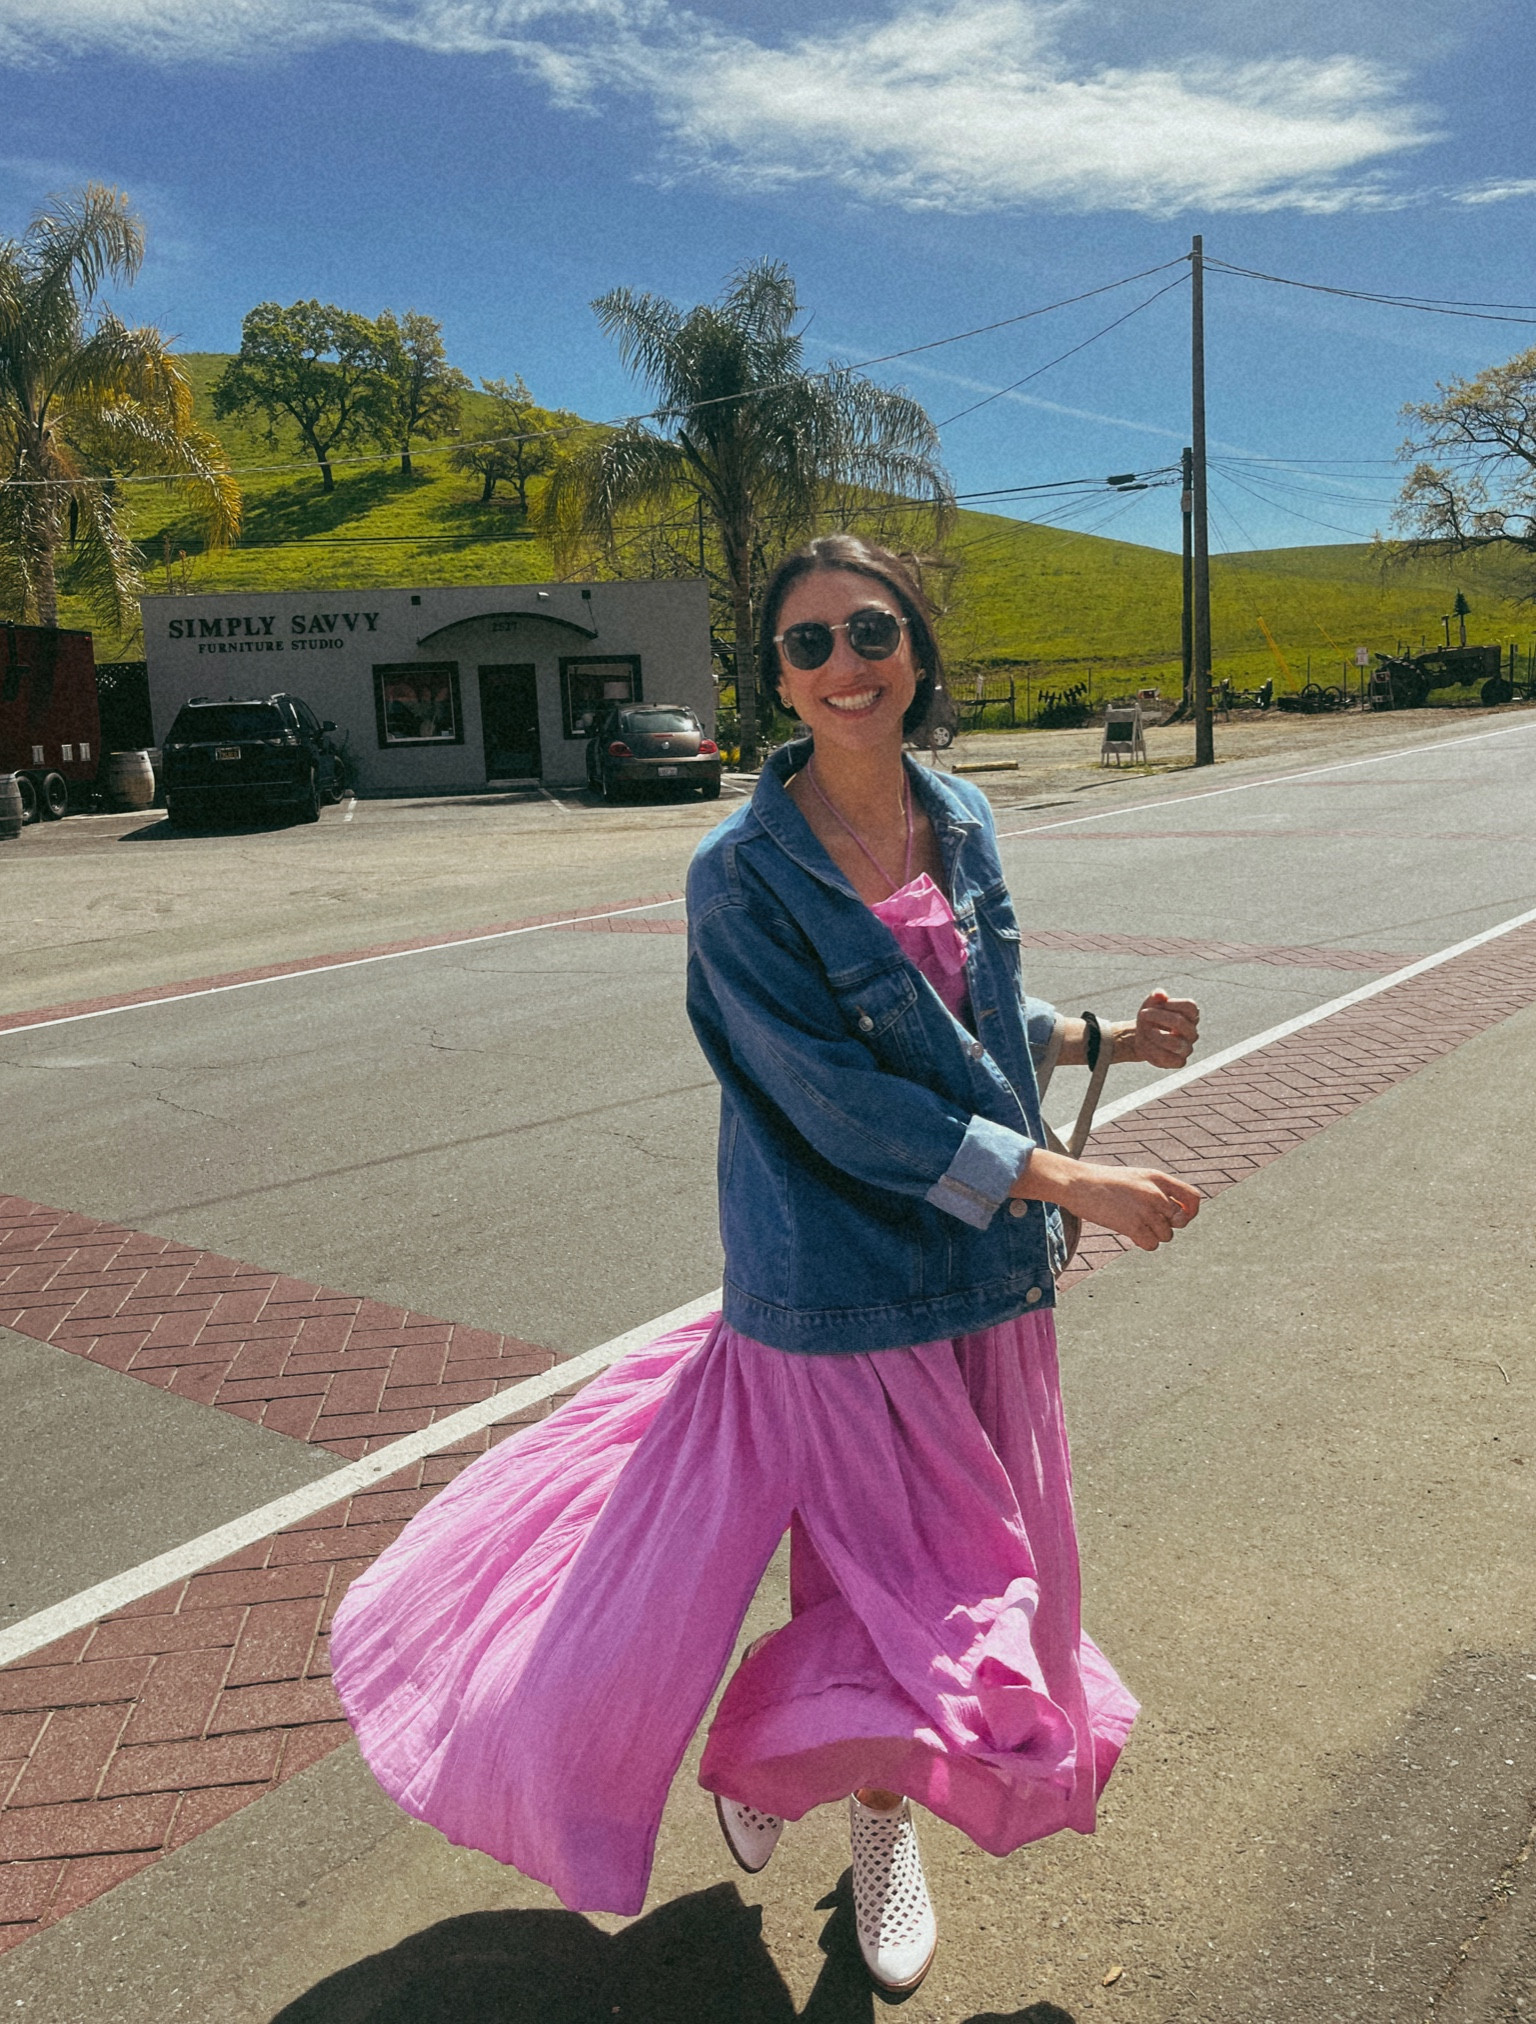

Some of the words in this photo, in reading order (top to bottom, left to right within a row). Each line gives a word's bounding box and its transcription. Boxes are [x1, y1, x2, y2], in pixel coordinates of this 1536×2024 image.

[168, 616, 276, 640] SIMPLY
[291, 612, 380, 635] SAVVY
[198, 641, 285, 654] FURNITURE
[291, 638, 344, 651] STUDIO
